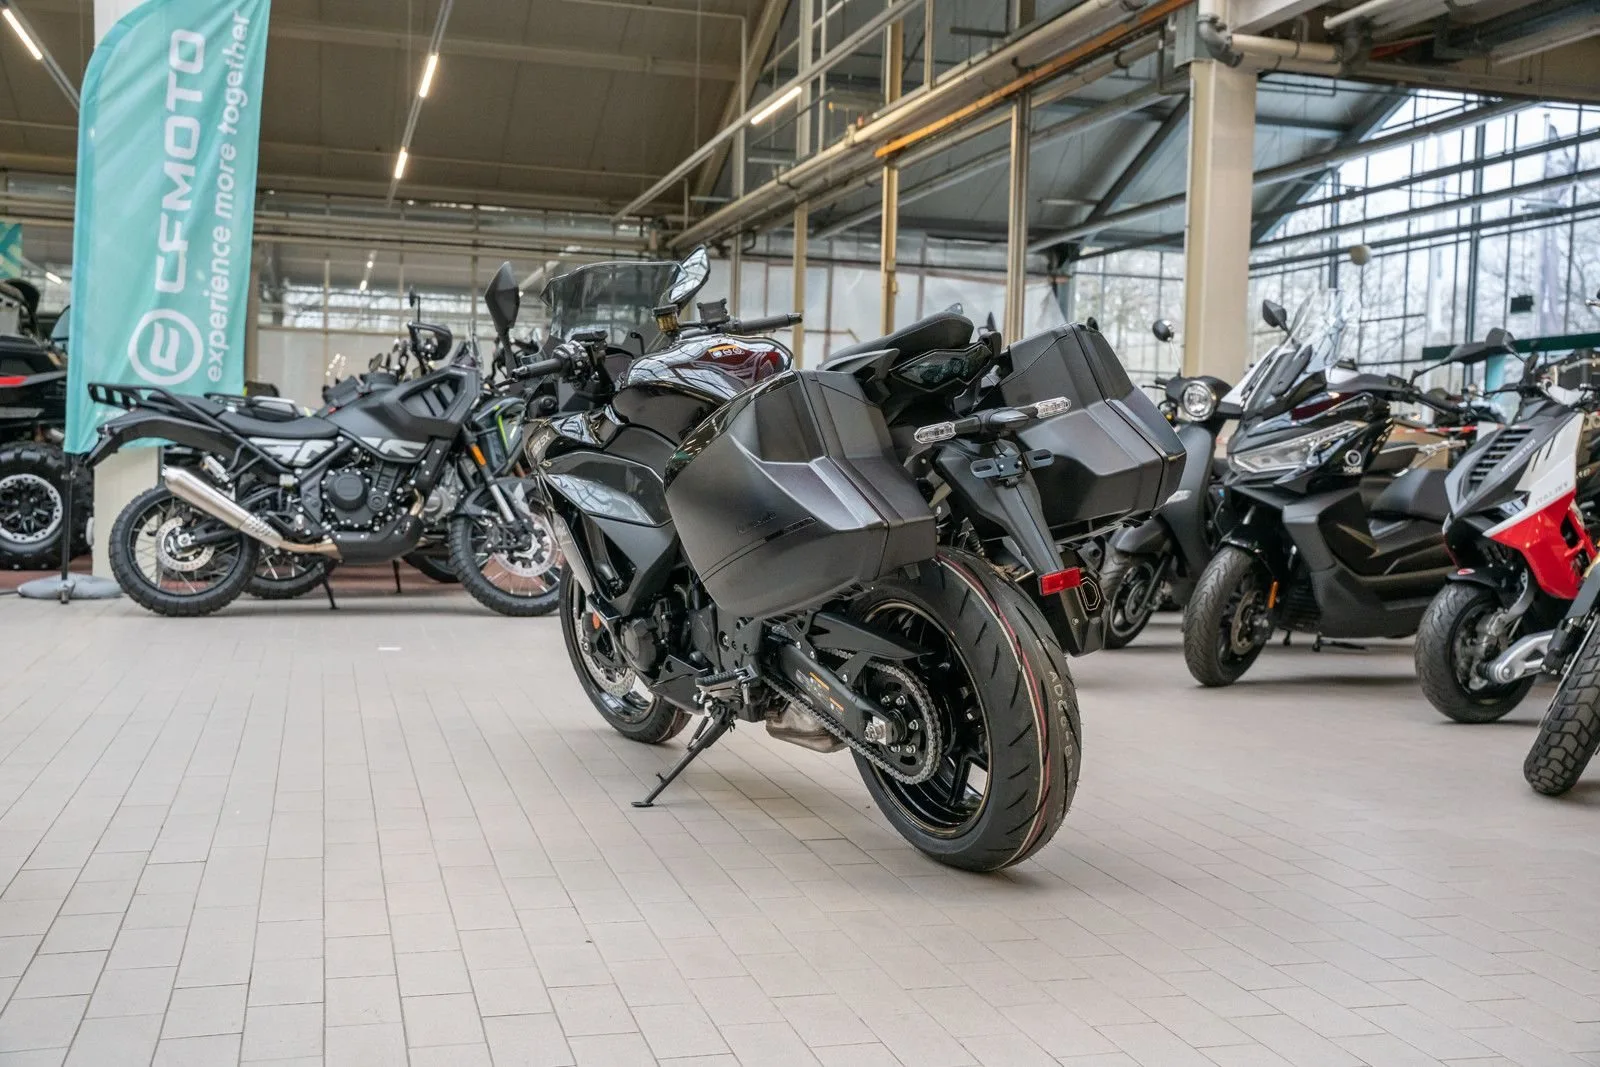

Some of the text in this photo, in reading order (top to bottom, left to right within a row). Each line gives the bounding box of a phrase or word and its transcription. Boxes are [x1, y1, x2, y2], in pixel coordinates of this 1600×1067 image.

[154, 28, 205, 294] CFMOTO
[203, 10, 250, 383] experience more together
